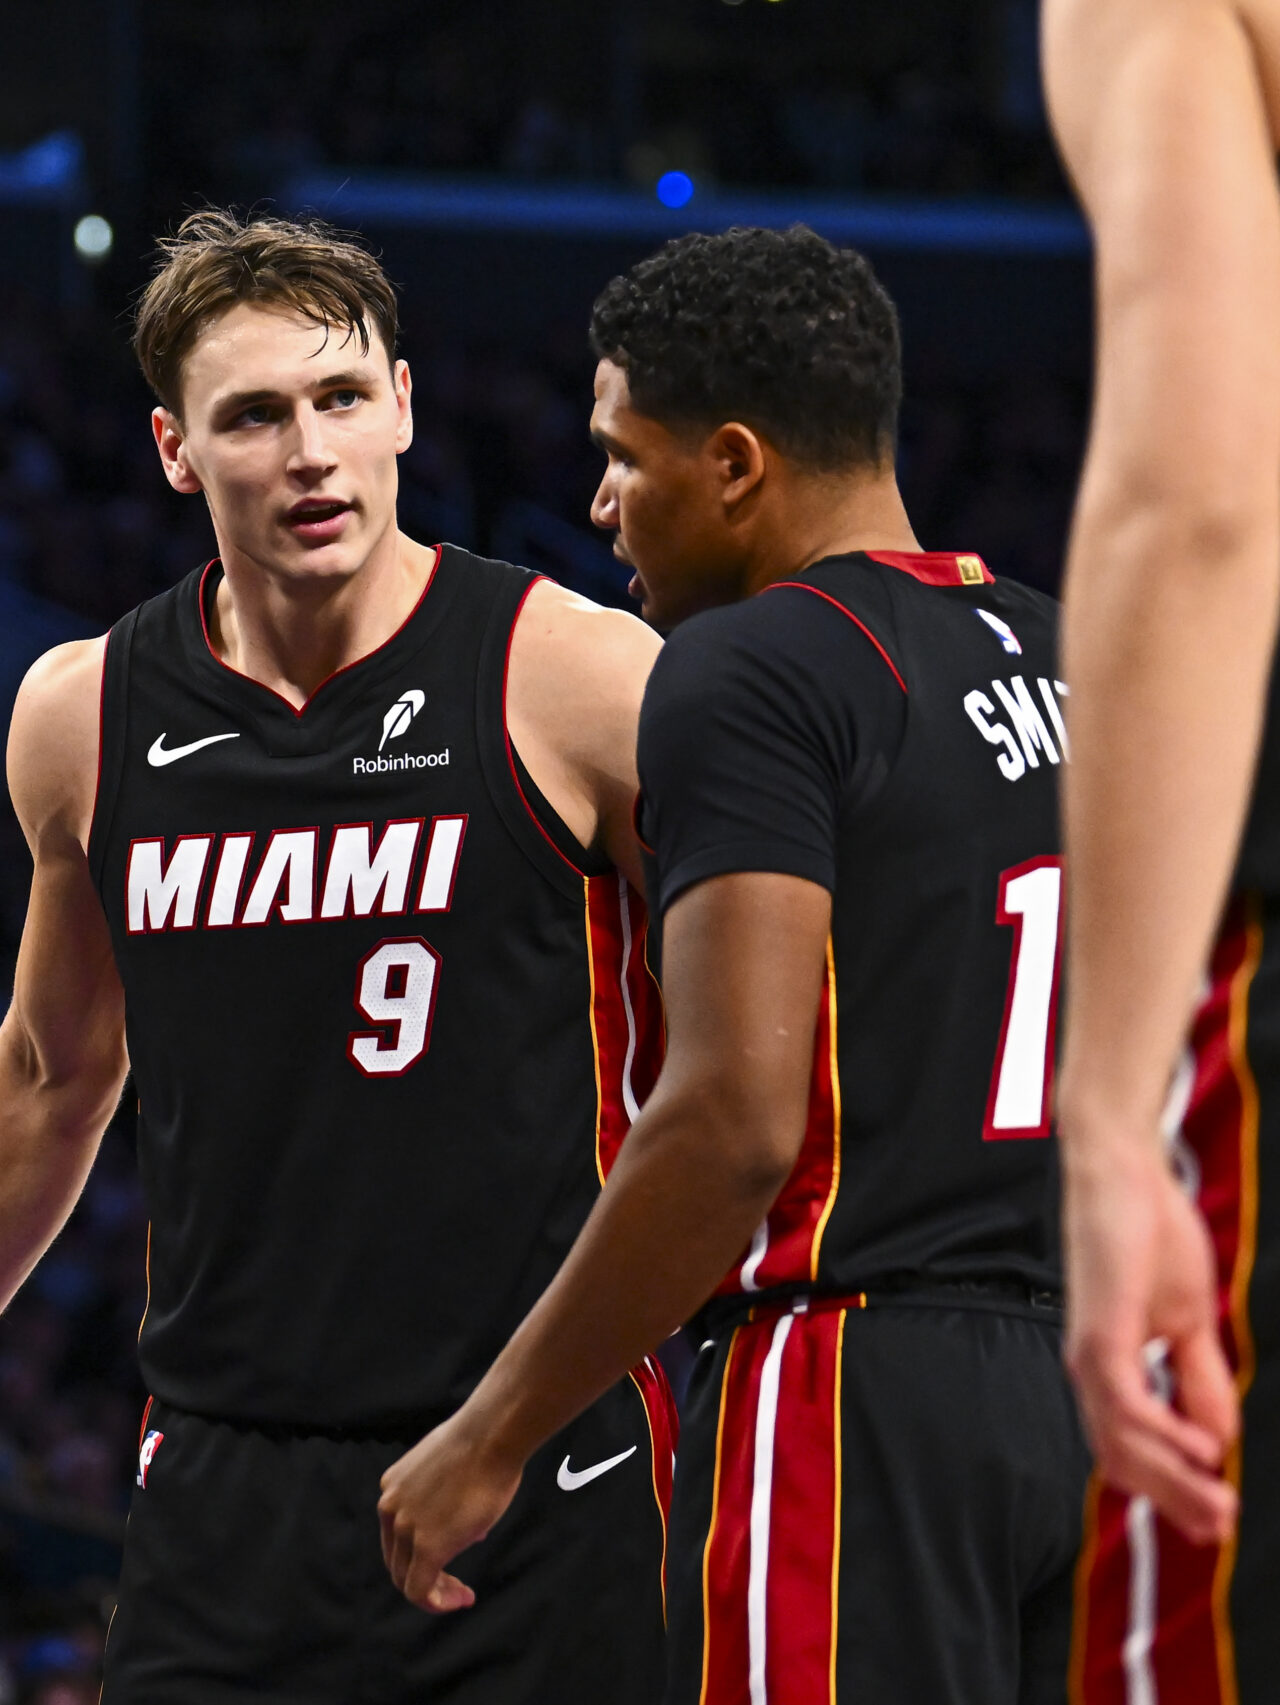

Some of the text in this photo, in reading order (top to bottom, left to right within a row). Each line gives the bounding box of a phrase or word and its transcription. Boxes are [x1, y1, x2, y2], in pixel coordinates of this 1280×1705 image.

[353, 748, 450, 774] Robinhood
[963, 675, 1071, 782] SMI
[124, 813, 469, 936] MIAMI
[346, 935, 443, 1078] 9
